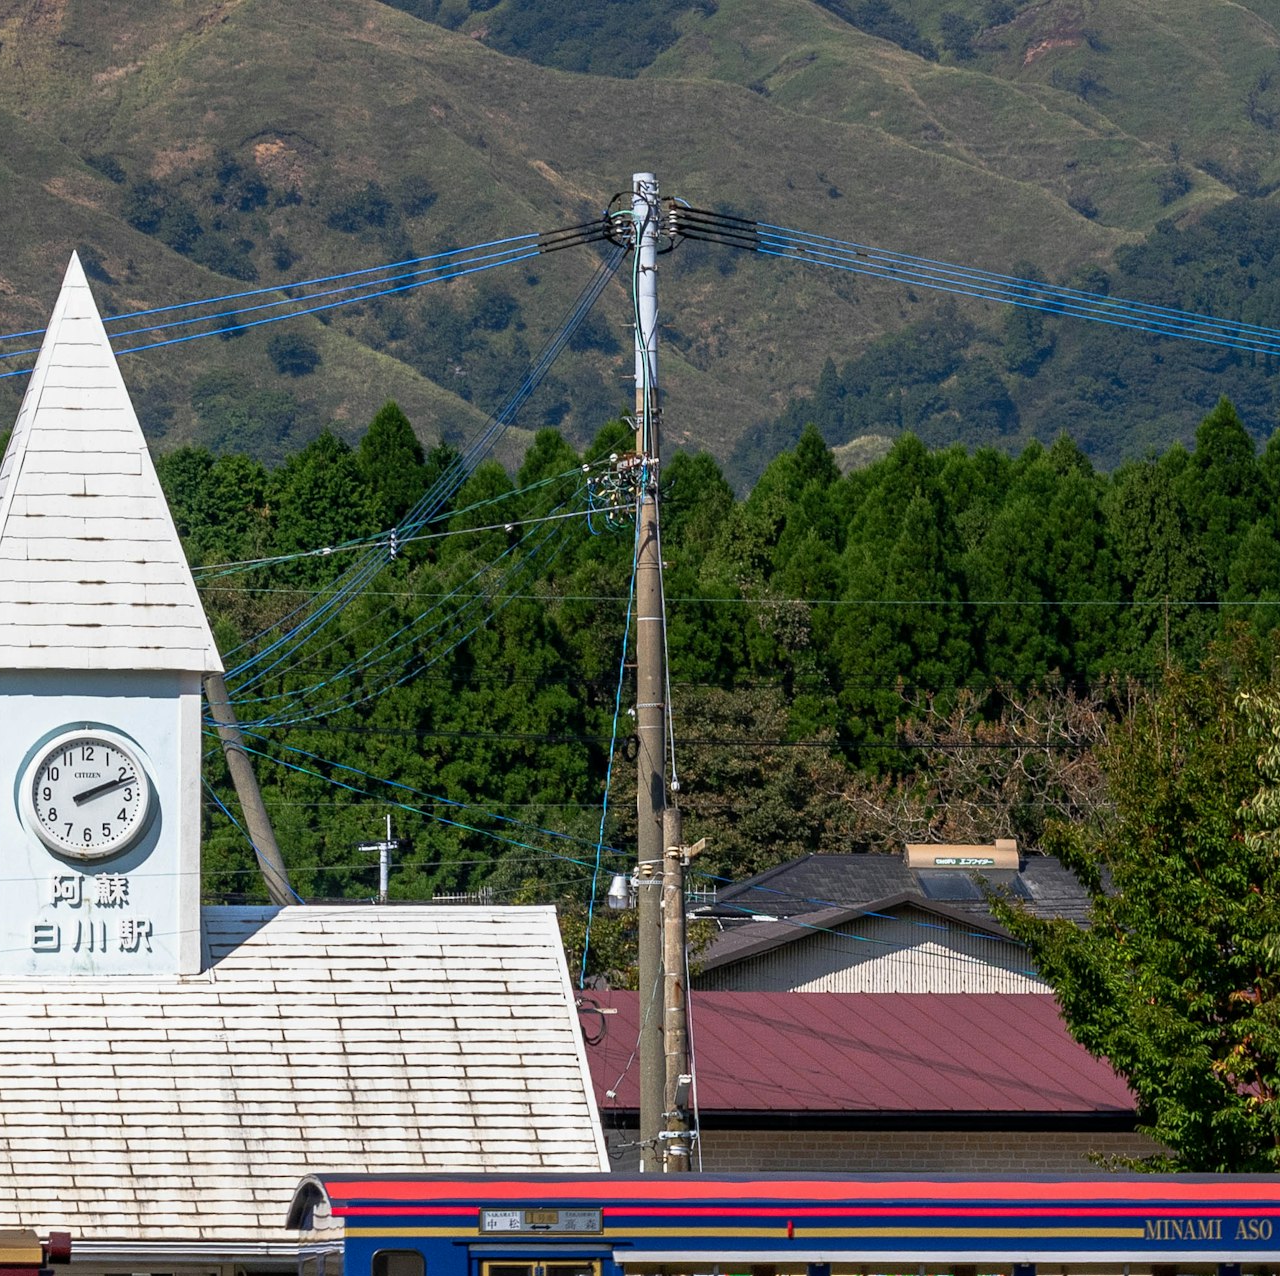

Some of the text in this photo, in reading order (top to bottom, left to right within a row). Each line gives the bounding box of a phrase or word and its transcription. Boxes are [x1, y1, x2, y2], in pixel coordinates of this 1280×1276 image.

[63, 751, 73, 767] 11
[81, 746, 95, 762] 12
[46, 767, 60, 782] 10
[118, 766, 128, 782] 2
[42, 787, 52, 802] 9
[124, 787, 133, 802] 3
[48, 807, 58, 822] 8
[117, 807, 128, 822] 4
[64, 822, 74, 838] 7
[83, 827, 92, 843] 6
[102, 822, 111, 838] 5
[51, 872, 130, 908] 阿蘇
[31, 918, 153, 953] 白川駅
[1145, 1219, 1223, 1241] MINAMI
[1234, 1219, 1273, 1241] ASO
